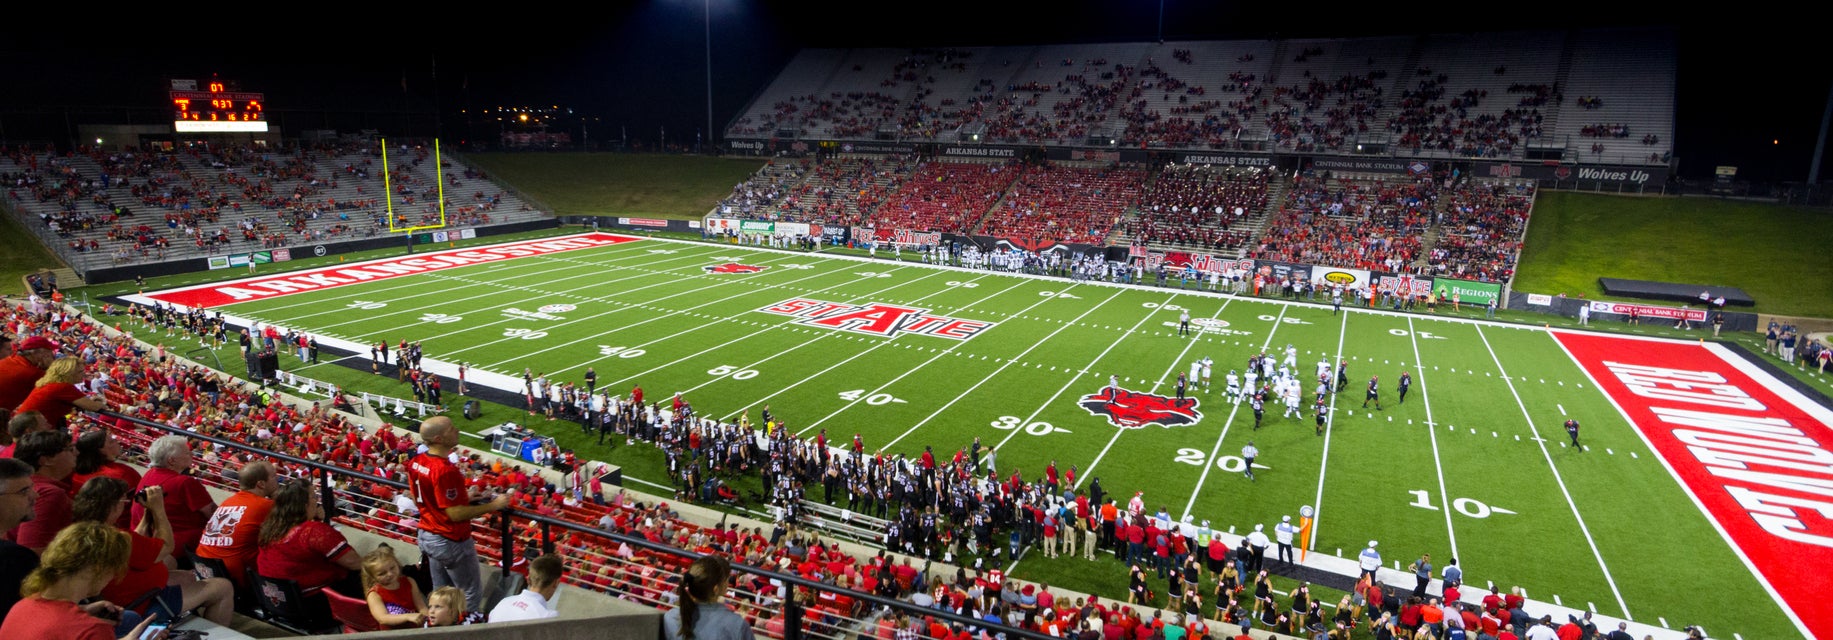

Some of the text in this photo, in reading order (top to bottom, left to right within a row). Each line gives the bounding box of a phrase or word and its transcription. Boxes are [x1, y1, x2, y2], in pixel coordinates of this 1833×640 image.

[211, 84, 223, 92] 07
[755, 142, 764, 150] Up
[946, 148, 988, 156] ARKANSAS
[1184, 155, 1270, 166] ARKANSAS STATE
[1314, 160, 1352, 168] CENTENNIAL
[1578, 168, 1649, 184] Wolves Up
[742, 222, 772, 230] SUBWAY
[215, 238, 615, 300] ARKANSAS STATE
[1452, 286, 1498, 298] REGIONS
[1614, 304, 1653, 314] CENTNIAL
[755, 297, 1000, 339] STATE
[707, 365, 760, 380] 50
[838, 389, 893, 406] 40
[990, 416, 1054, 436] 30
[1174, 448, 1250, 472] 20
[1602, 360, 1833, 549] RED WOLVES
[416, 480, 422, 503] 1
[1408, 490, 1491, 518] 10
[974, 516, 983, 526] 76
[888, 528, 898, 536] 79
